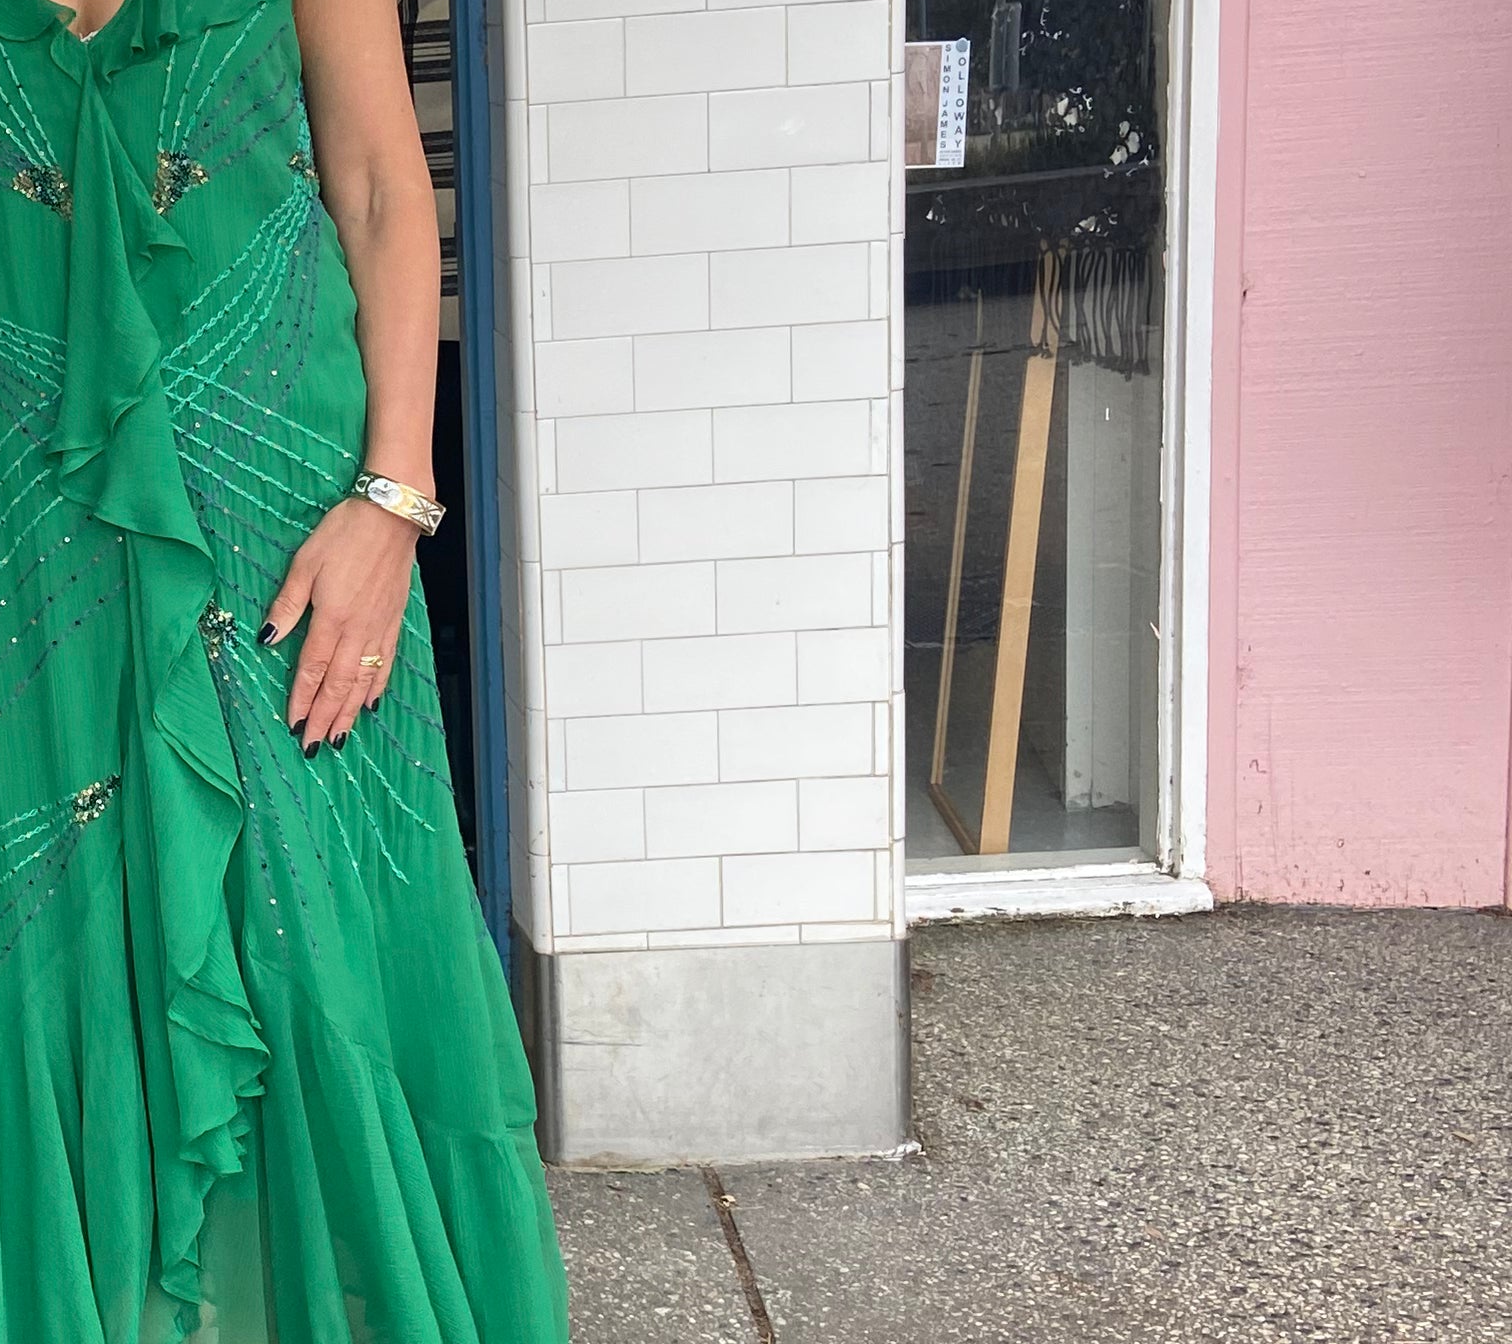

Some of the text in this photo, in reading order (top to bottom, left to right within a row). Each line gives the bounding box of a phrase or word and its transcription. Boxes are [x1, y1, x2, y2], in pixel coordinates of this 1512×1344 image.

[940, 44, 951, 149] SIMON JAMES
[954, 56, 967, 148] OLLOWAY
